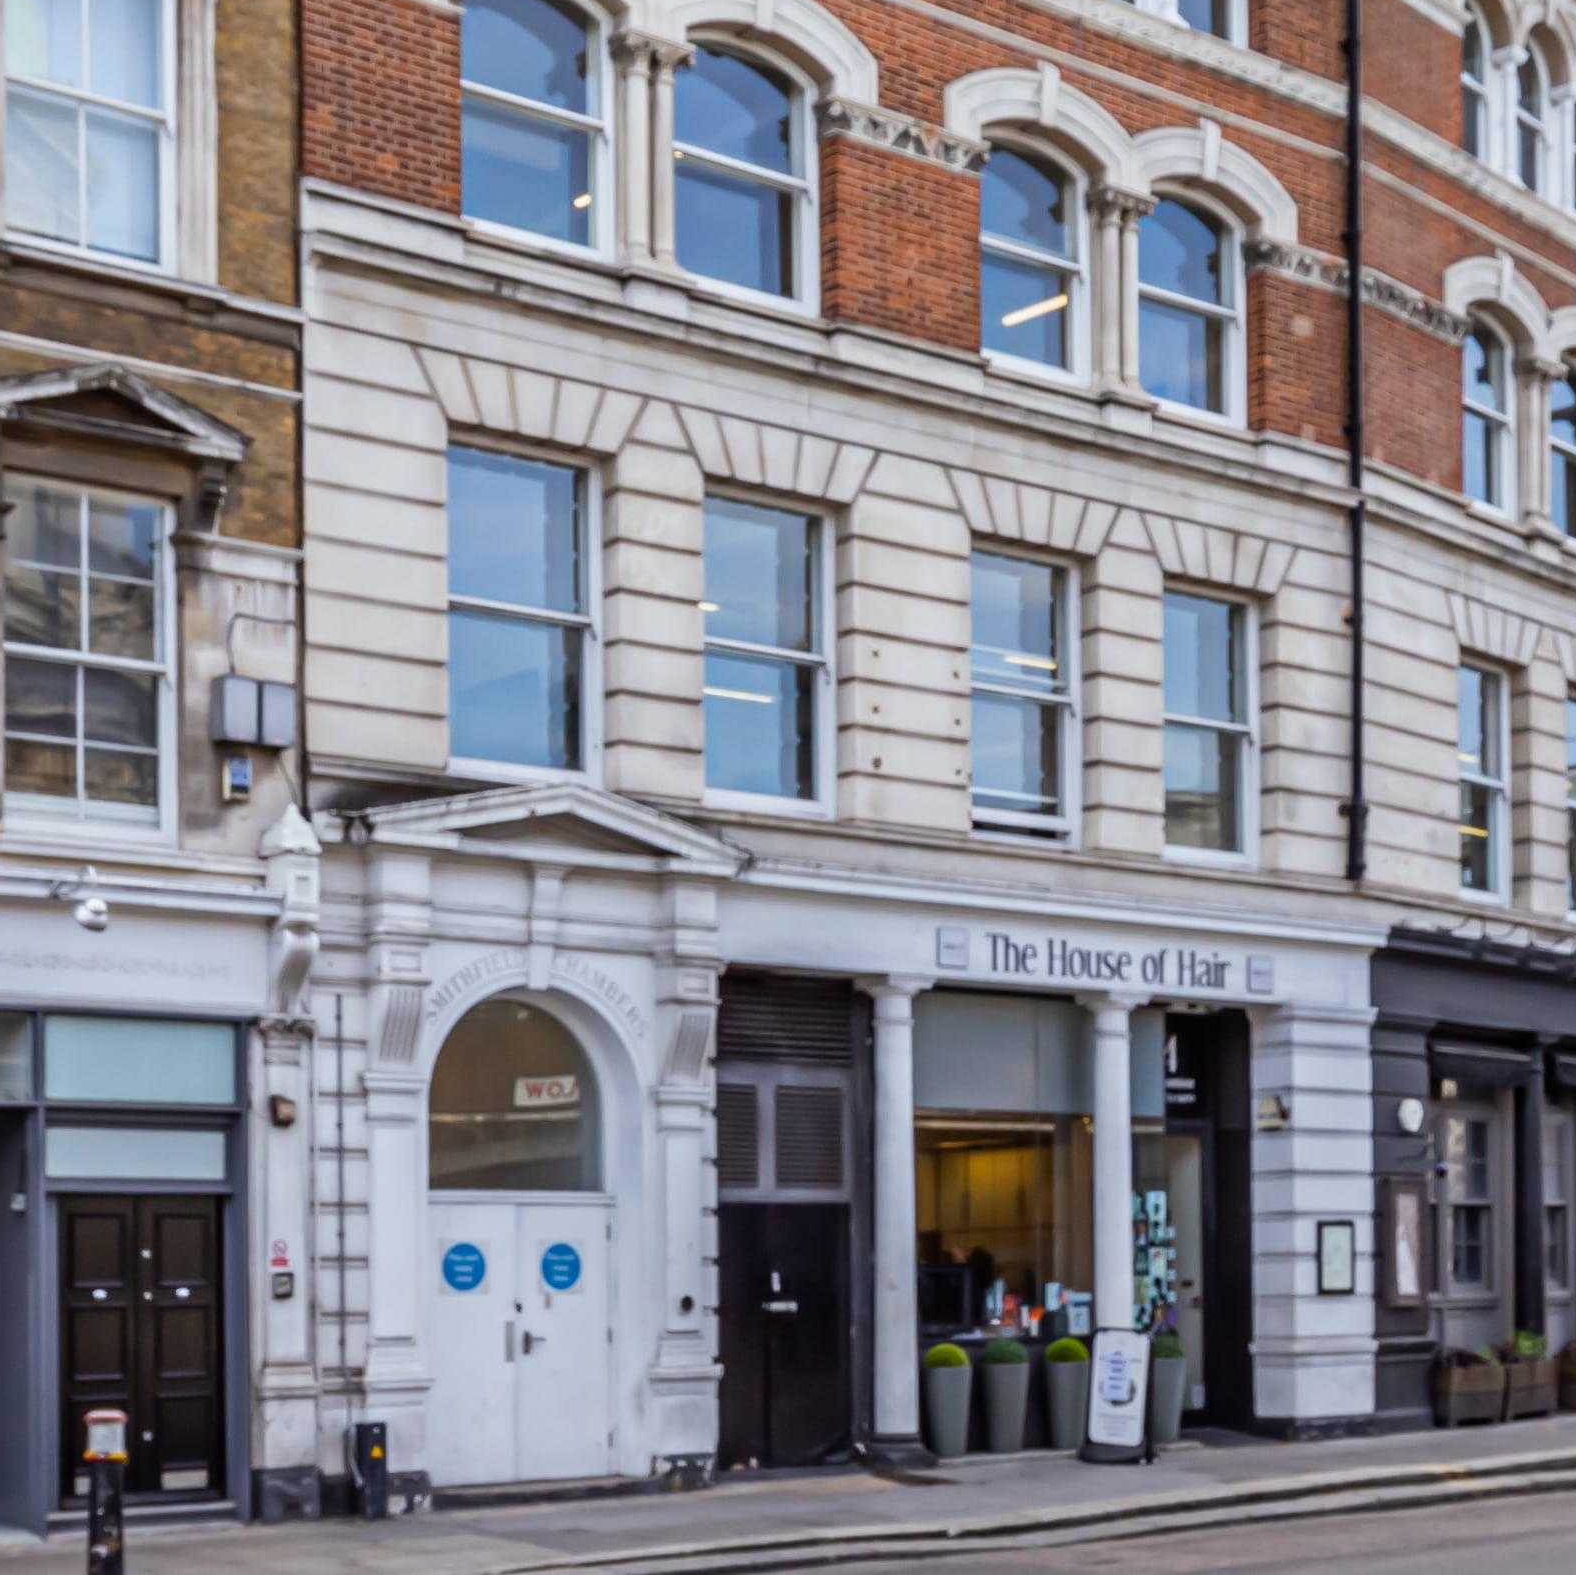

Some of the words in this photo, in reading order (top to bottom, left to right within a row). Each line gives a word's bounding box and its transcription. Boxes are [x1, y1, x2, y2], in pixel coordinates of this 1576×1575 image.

[985, 931, 1038, 974] The
[1047, 938, 1132, 982] House
[1141, 948, 1169, 985] of
[1178, 948, 1232, 990] Hair
